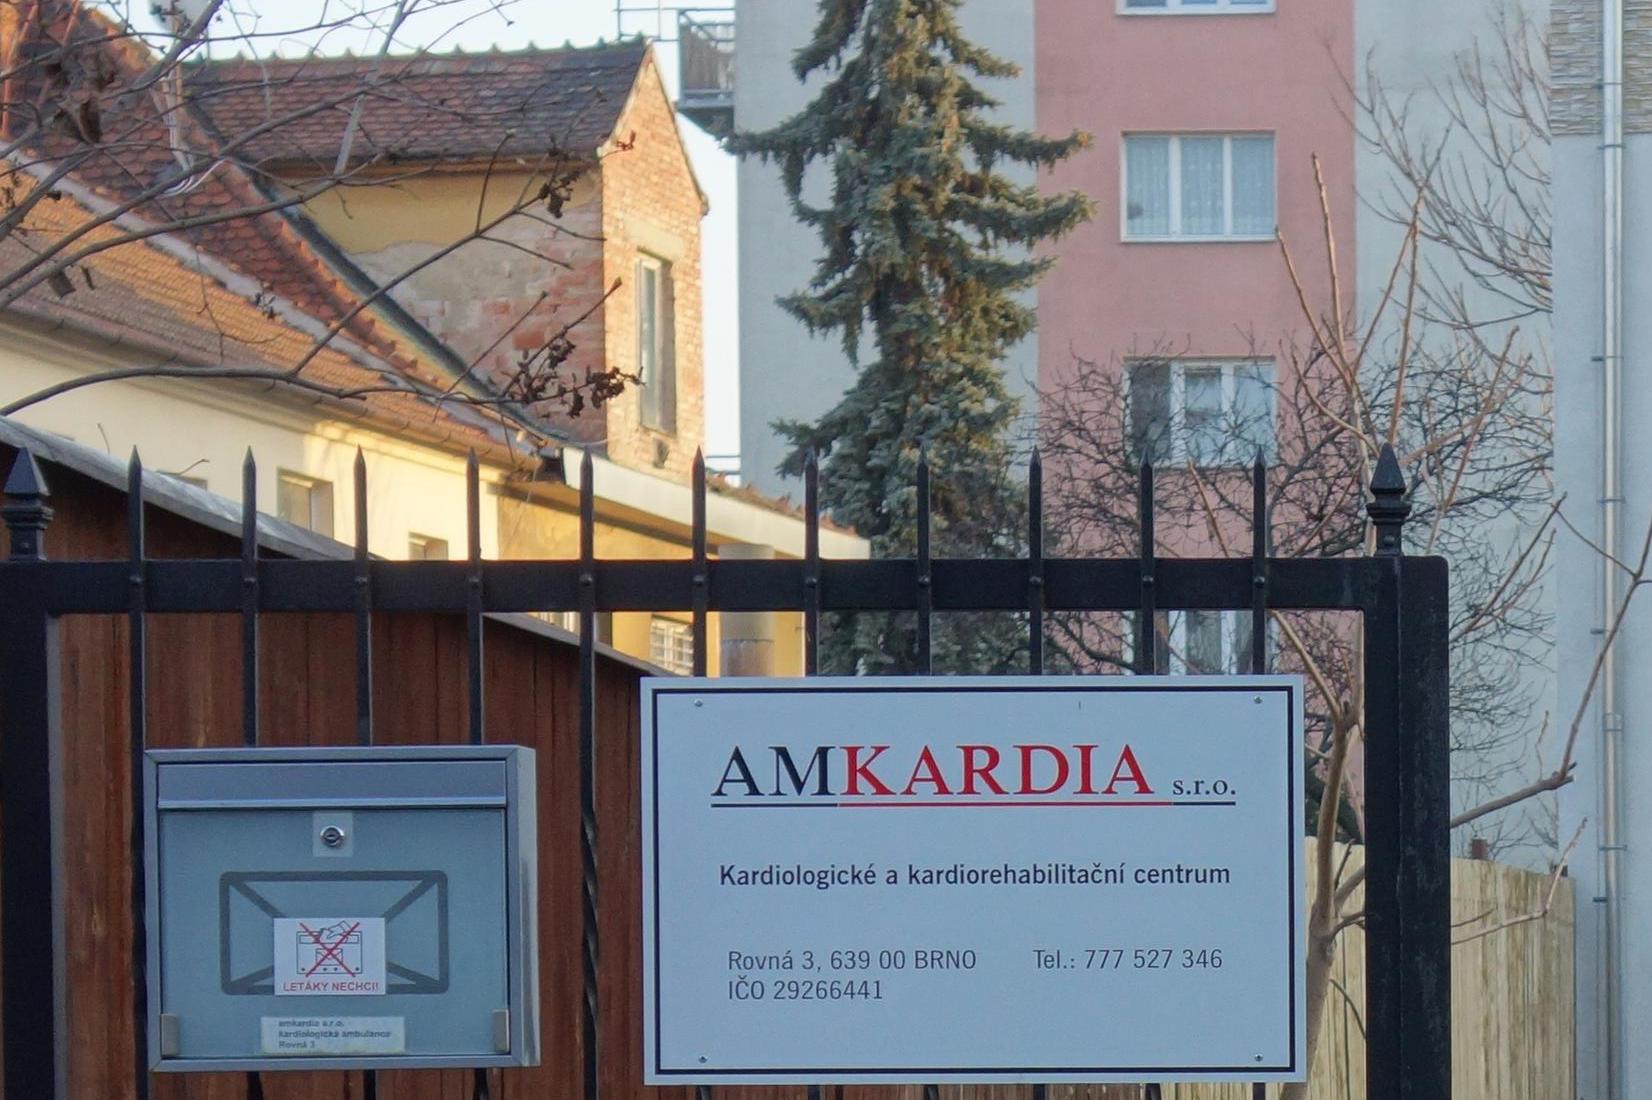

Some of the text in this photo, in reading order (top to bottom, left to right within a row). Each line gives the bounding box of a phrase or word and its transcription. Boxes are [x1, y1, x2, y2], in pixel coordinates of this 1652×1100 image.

[711, 743, 1236, 797] AMKARDIA s.r.o.
[719, 862, 1230, 890] Kardiologické a kardiorehabilitační centrum
[728, 949, 977, 974] Rovná 3, 639 00 BRNO
[1033, 948, 1223, 970] Tel.: 777 527 346
[283, 980, 328, 992] LETÁKY
[728, 974, 883, 1000] IČO 29266441
